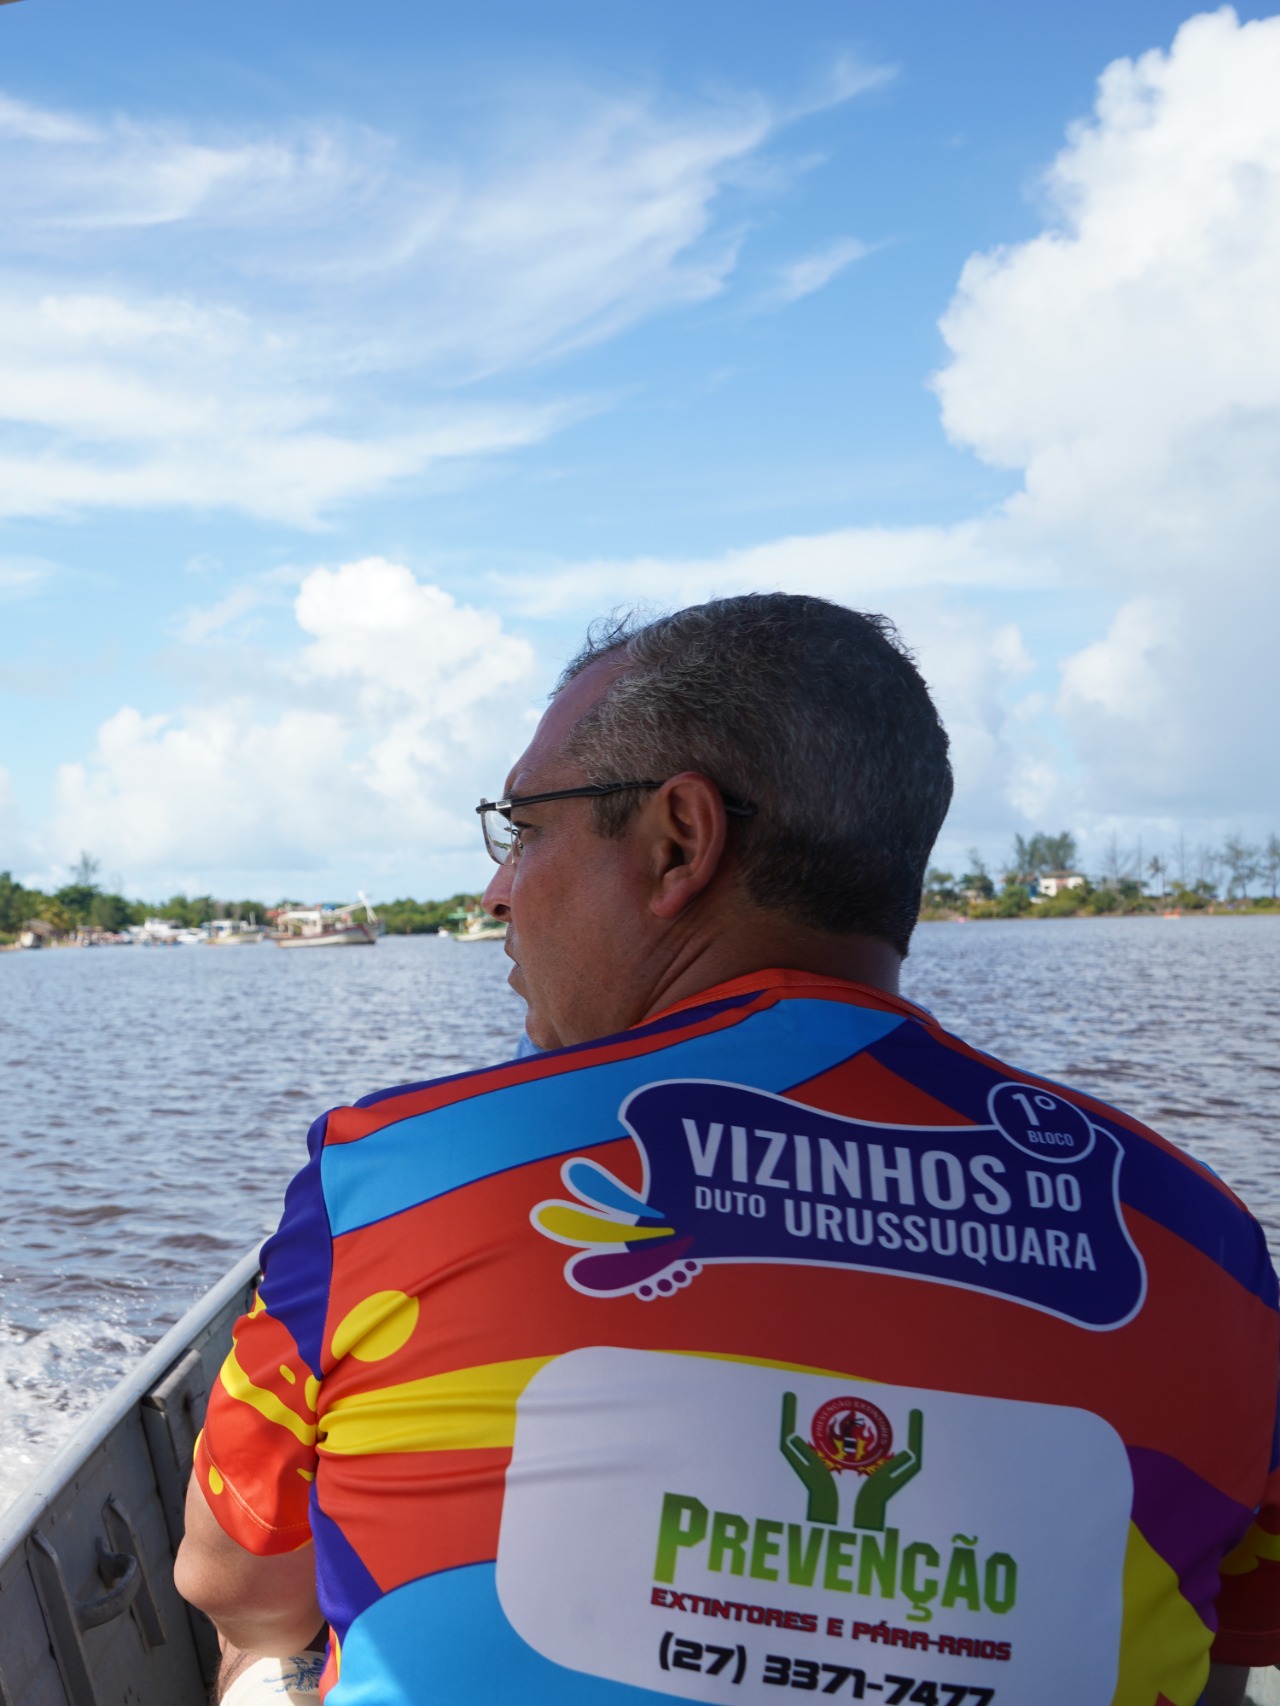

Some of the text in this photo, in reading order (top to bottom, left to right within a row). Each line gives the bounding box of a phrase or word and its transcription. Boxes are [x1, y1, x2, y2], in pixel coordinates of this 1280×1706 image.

[681, 1117, 1081, 1215] VIZINHOS DO
[1026, 1130, 1074, 1146] BLOCO
[695, 1185, 1096, 1272] DUTO URUSSUQUARA
[653, 1492, 1018, 1623] PREVENÇÃO
[651, 1587, 1012, 1660] EXTINTORES E PÁRA-RAIOS
[659, 1631, 995, 1706] (27) 3371-7477
